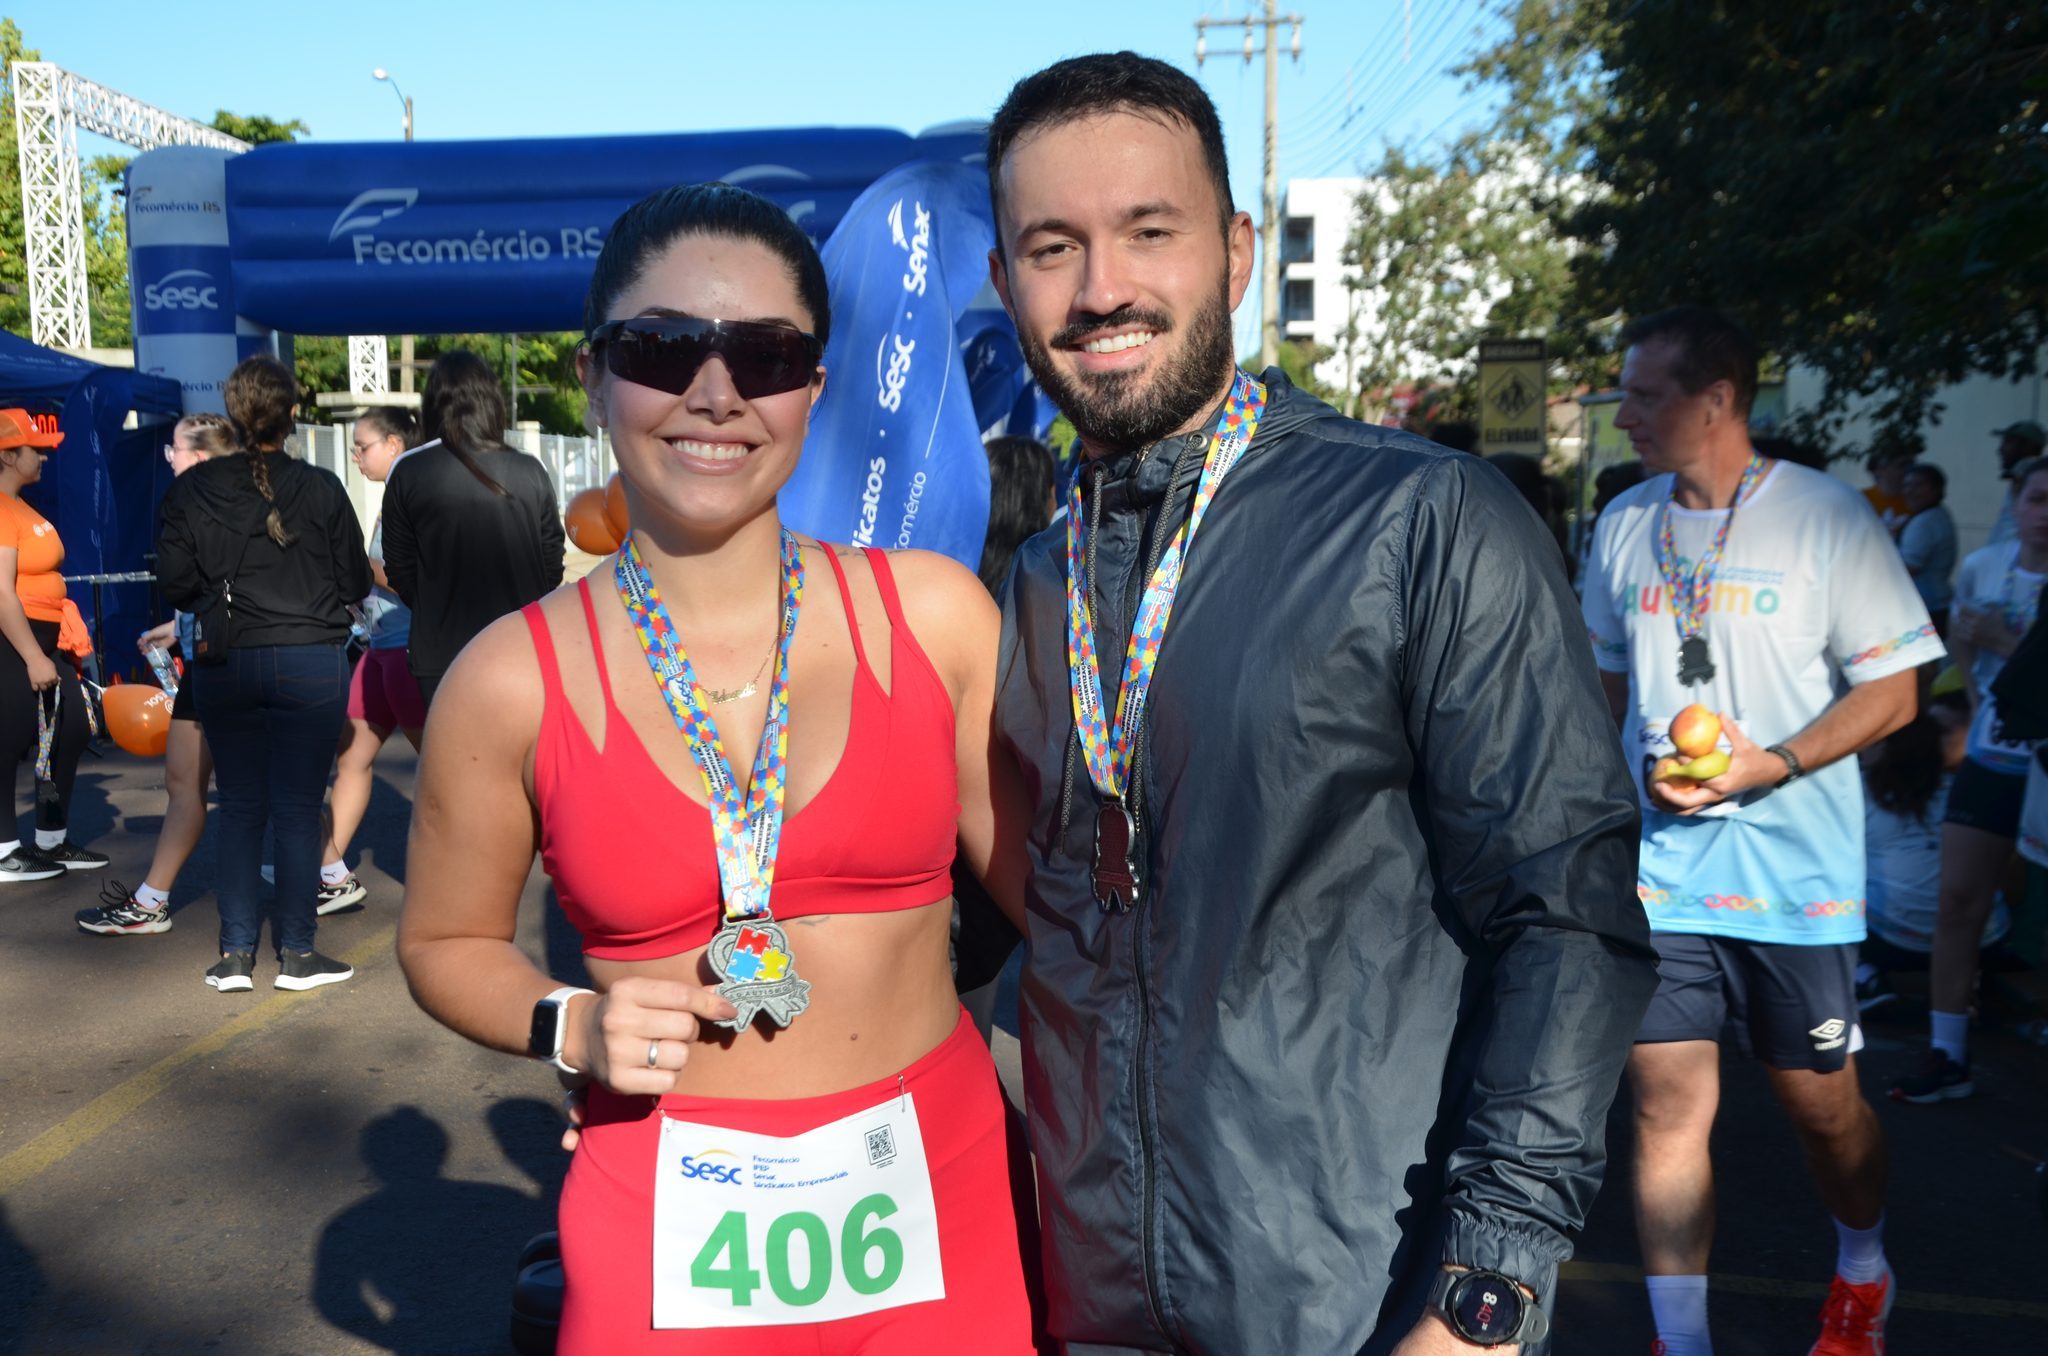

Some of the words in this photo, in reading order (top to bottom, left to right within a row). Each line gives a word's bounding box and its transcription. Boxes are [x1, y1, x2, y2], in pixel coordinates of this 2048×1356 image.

[352, 228, 550, 265] Fecomércio
[560, 226, 605, 260] RS
[144, 283, 219, 310] Sesc
[879, 332, 916, 413] Sesc
[675, 676, 695, 706] Sesc
[681, 1155, 743, 1186] Sesc
[690, 1193, 904, 1307] 406
